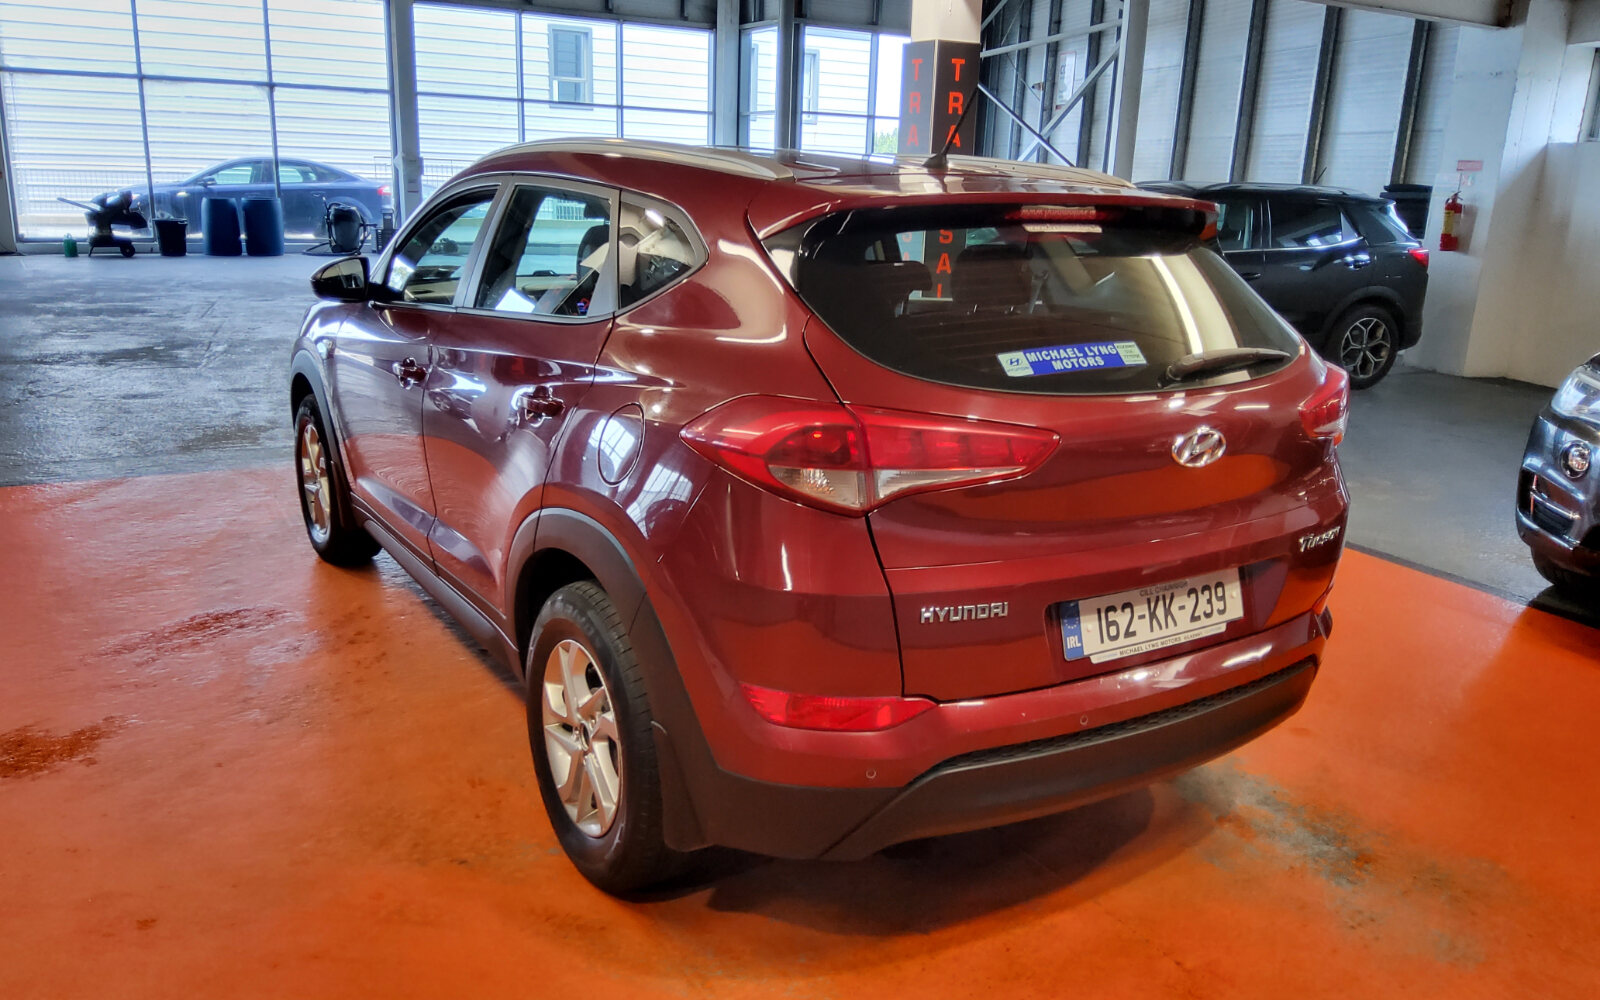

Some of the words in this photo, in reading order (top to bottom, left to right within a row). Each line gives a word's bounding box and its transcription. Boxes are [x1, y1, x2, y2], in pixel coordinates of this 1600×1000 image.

[1025, 347, 1083, 363] MICHAEL
[1084, 344, 1117, 356] LYNG
[1051, 356, 1105, 371] MOTORS
[920, 602, 1008, 623] HYUNDAI
[1096, 581, 1227, 644] 162-KK-239
[1066, 635, 1082, 649] IRL
[1119, 645, 1144, 656] MICHAEL
[1160, 636, 1182, 646] MOTORS
